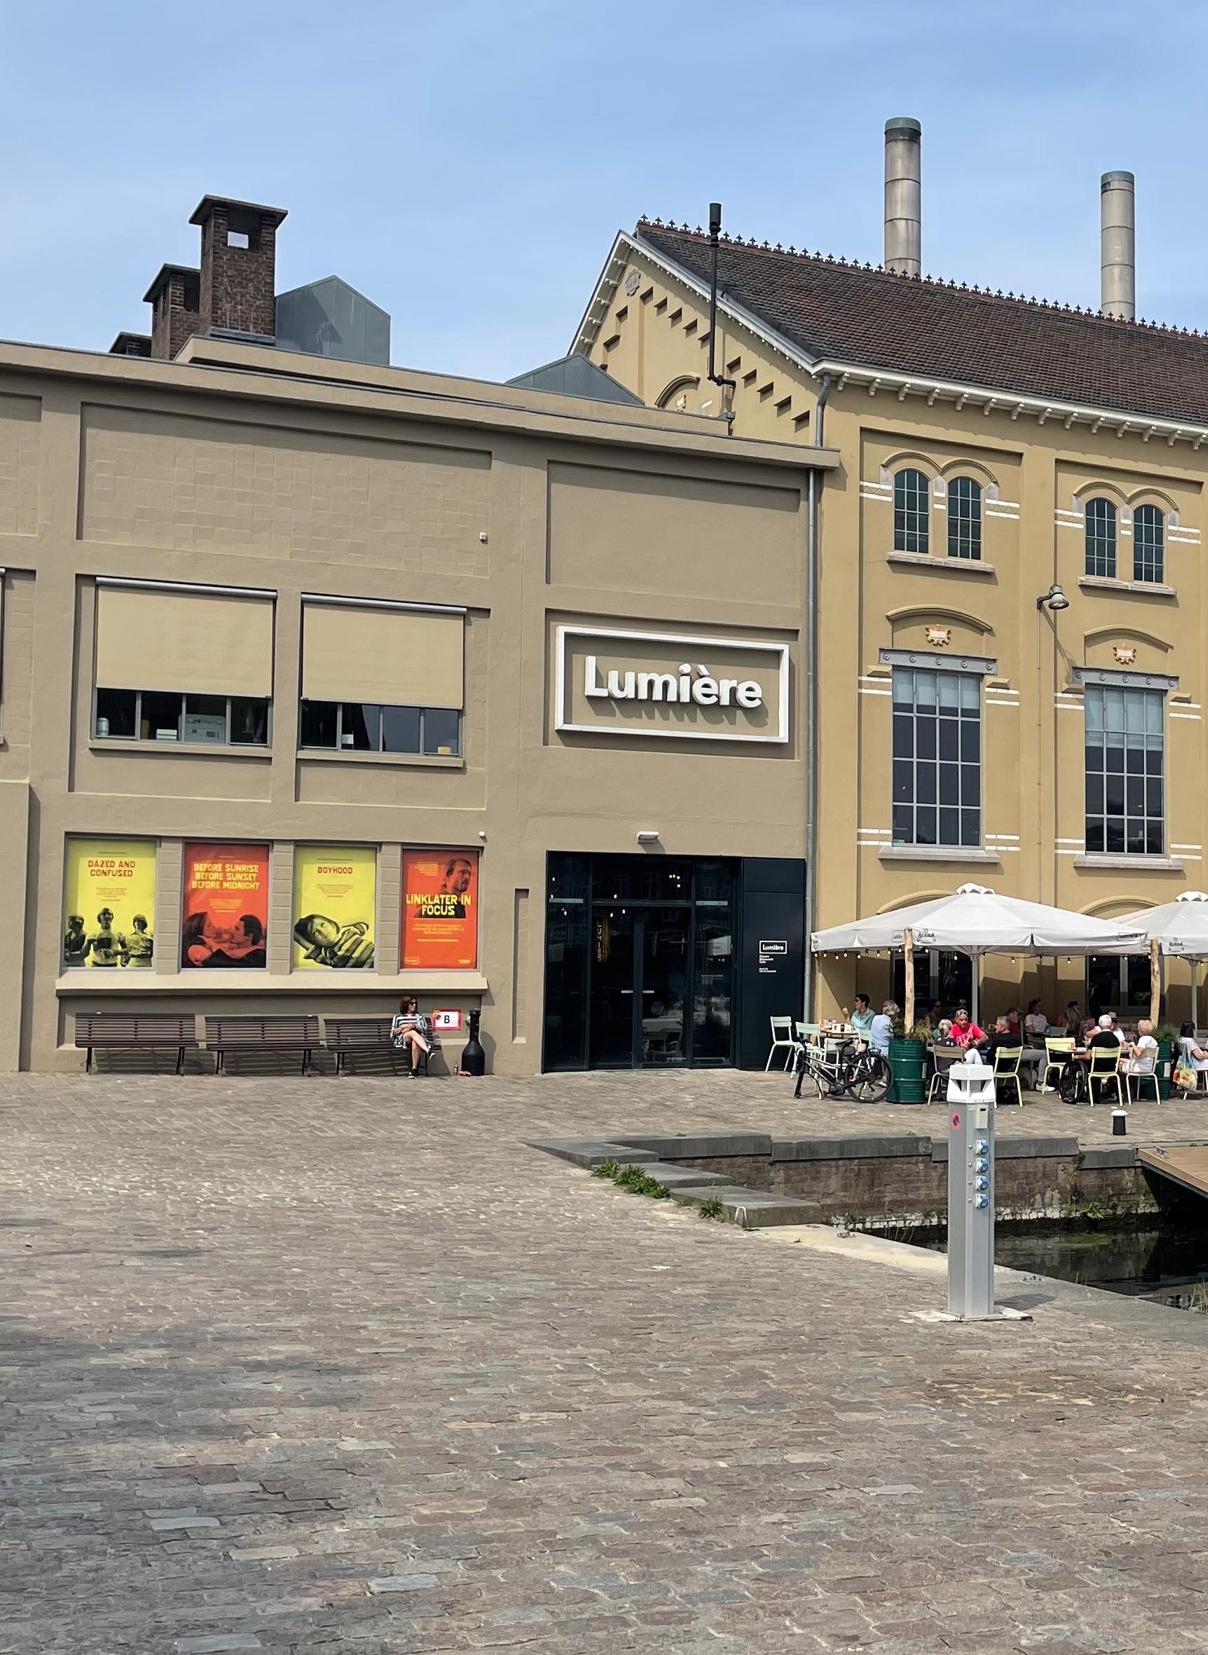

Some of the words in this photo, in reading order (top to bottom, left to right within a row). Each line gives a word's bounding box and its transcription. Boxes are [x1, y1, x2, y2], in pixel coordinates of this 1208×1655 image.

[584, 655, 763, 709] Lumière
[87, 860, 115, 868] DAZED
[118, 860, 136, 869] AND
[193, 863, 223, 872] BEFORE
[224, 864, 260, 873] SUNRISE
[89, 869, 134, 878] CONFUSED
[317, 866, 353, 875] BOYHOOD
[194, 872, 224, 880] BEFORE
[226, 873, 258, 882] SUNSET
[191, 881, 221, 890] BEFORE
[222, 882, 260, 891] MIDNIGHT
[406, 894, 458, 905] LINKLATER
[460, 895, 472, 905] IN
[421, 904, 455, 916] FOCUS
[444, 1014, 451, 1024] B
